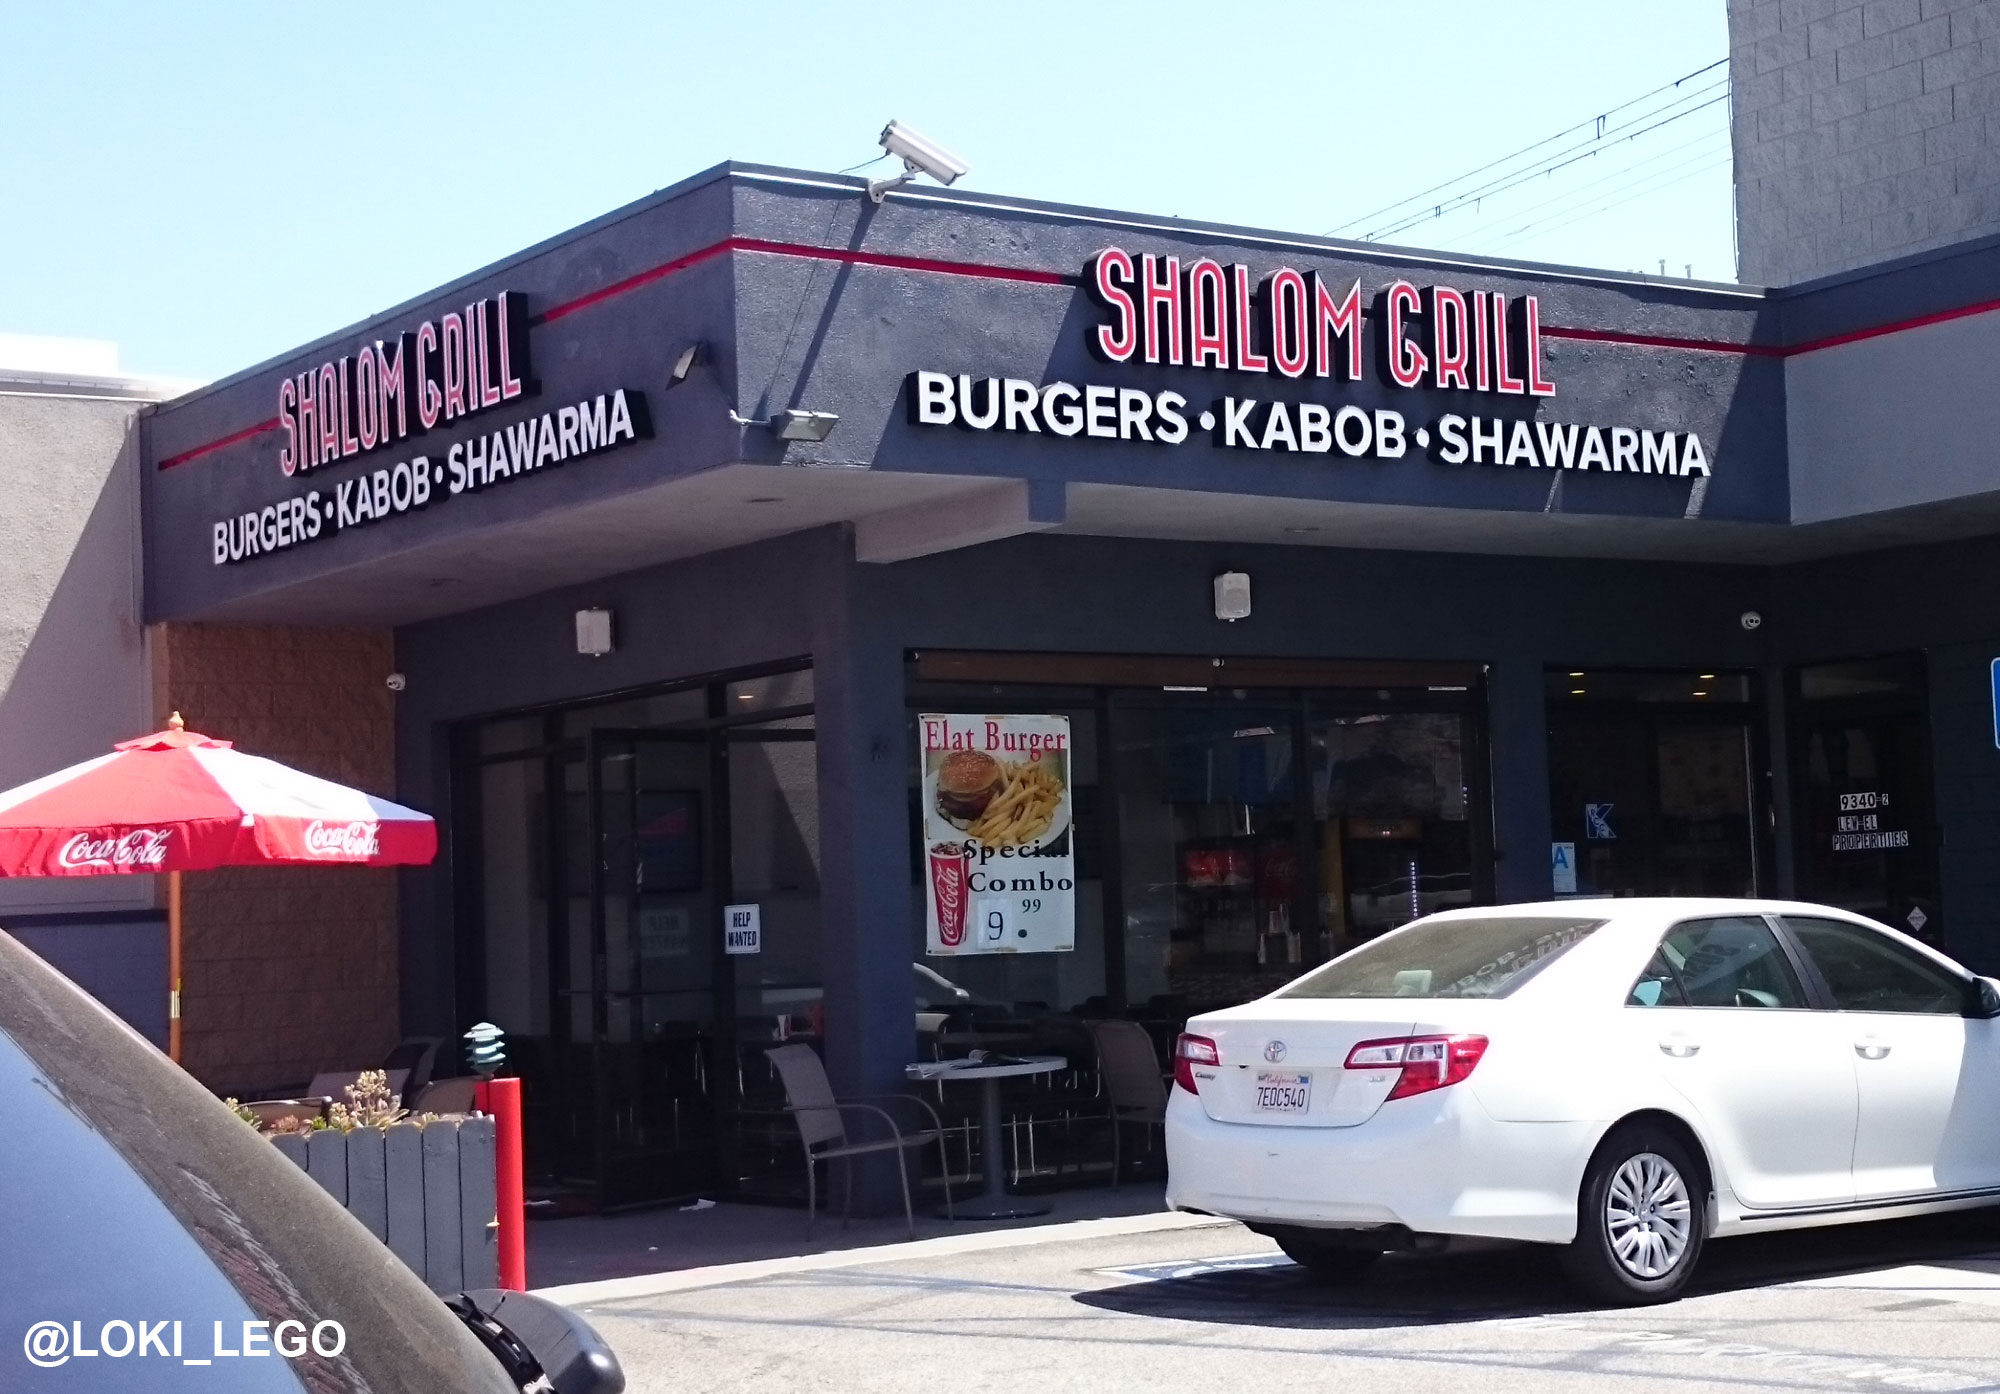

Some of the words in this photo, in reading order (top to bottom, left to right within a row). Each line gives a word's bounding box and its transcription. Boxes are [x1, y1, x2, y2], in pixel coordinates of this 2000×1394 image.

[1095, 246, 1363, 380] SHALOM
[1387, 280, 1556, 397] GRILL
[280, 331, 406, 477] SHALOM
[416, 290, 522, 429] GRILL
[917, 370, 1190, 444] BURGERS
[1224, 397, 1407, 459] KABOB
[1439, 413, 1711, 478] SHAWARMA
[213, 491, 321, 565] BURGERS
[337, 456, 430, 528] KABOB
[449, 388, 635, 494] SHAWARMA
[925, 720, 974, 751] Elat
[985, 721, 1066, 762] Burger
[1833, 831, 1908, 850] PROPERTIES
[1553, 846, 1569, 869] A
[968, 871, 1073, 892] Combo
[732, 911, 751, 928] HELP
[728, 931, 757, 947] WANTED
